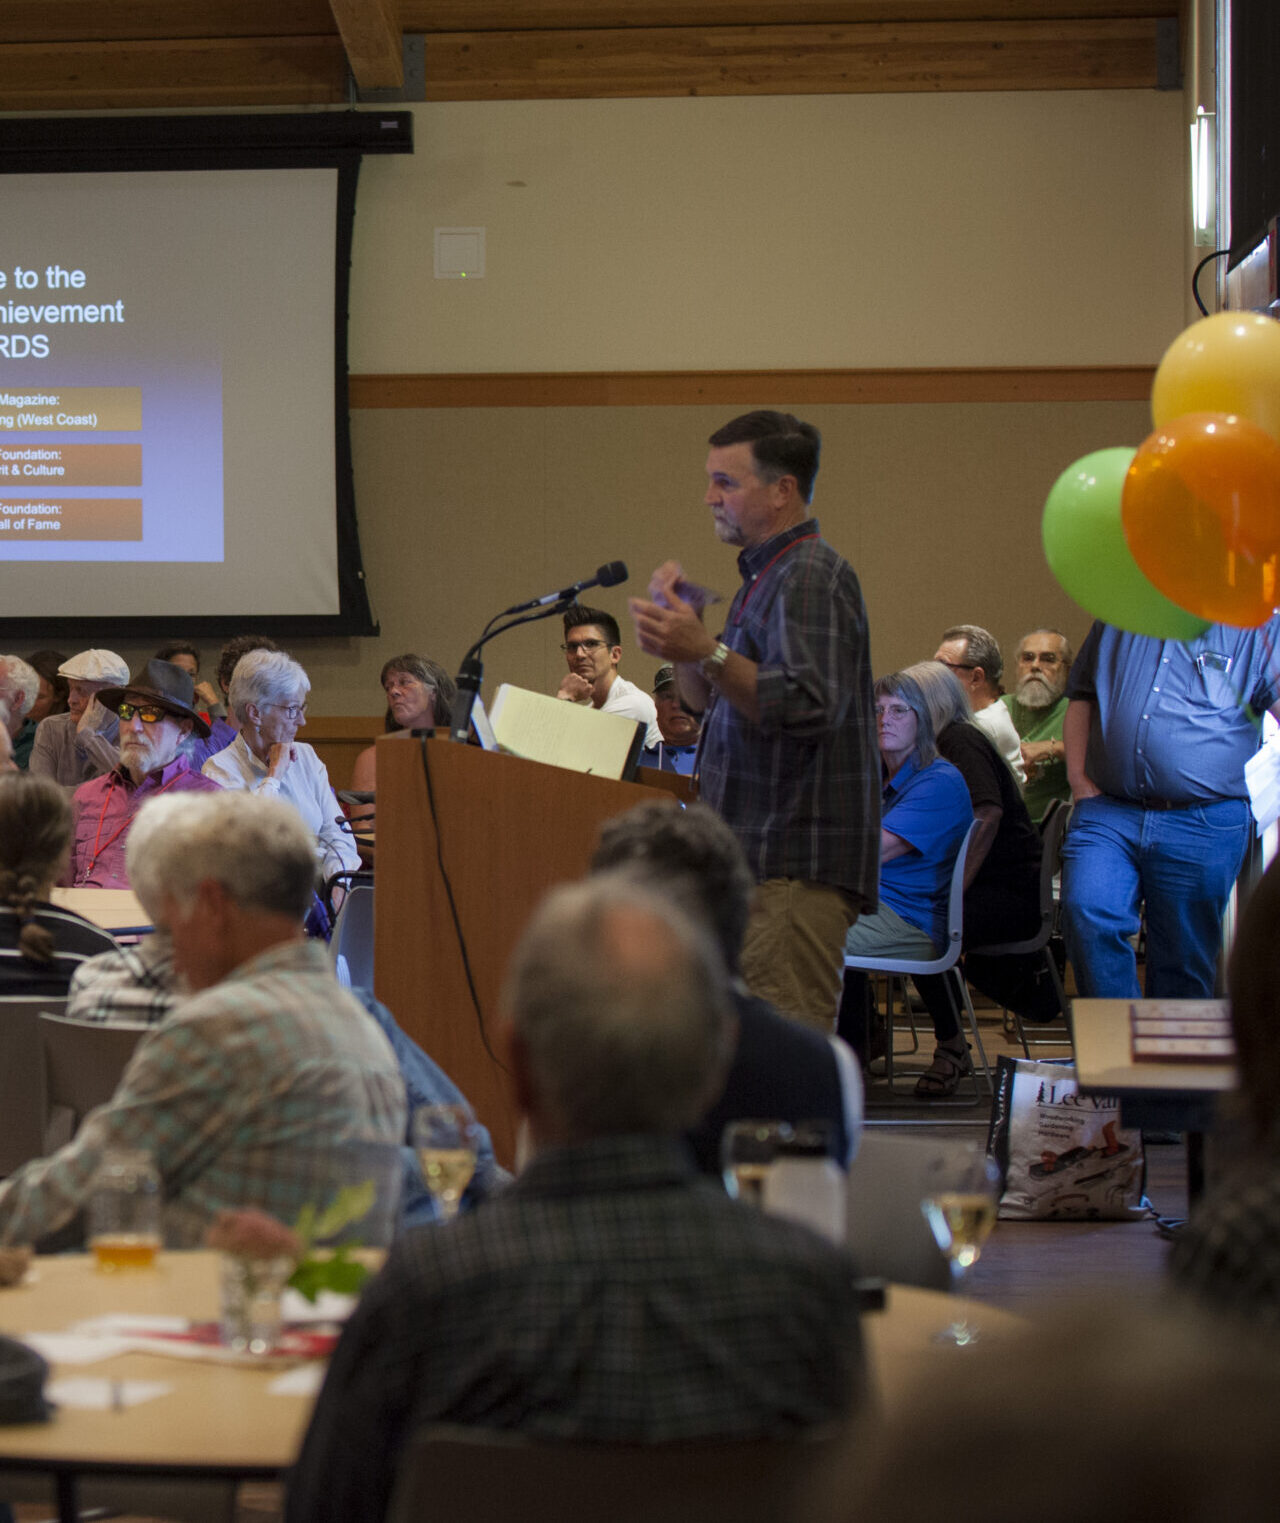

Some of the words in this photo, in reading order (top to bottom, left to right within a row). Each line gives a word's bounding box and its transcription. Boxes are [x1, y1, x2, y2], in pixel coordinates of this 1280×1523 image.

[14, 266, 38, 289] to
[45, 264, 86, 288] the
[17, 413, 54, 428] (West
[56, 412, 98, 427] Coast)
[11, 464, 21, 476] &
[23, 464, 65, 476] Culture
[13, 518, 25, 531] of
[28, 518, 61, 531] Fame
[1050, 1085, 1086, 1107] Lee
